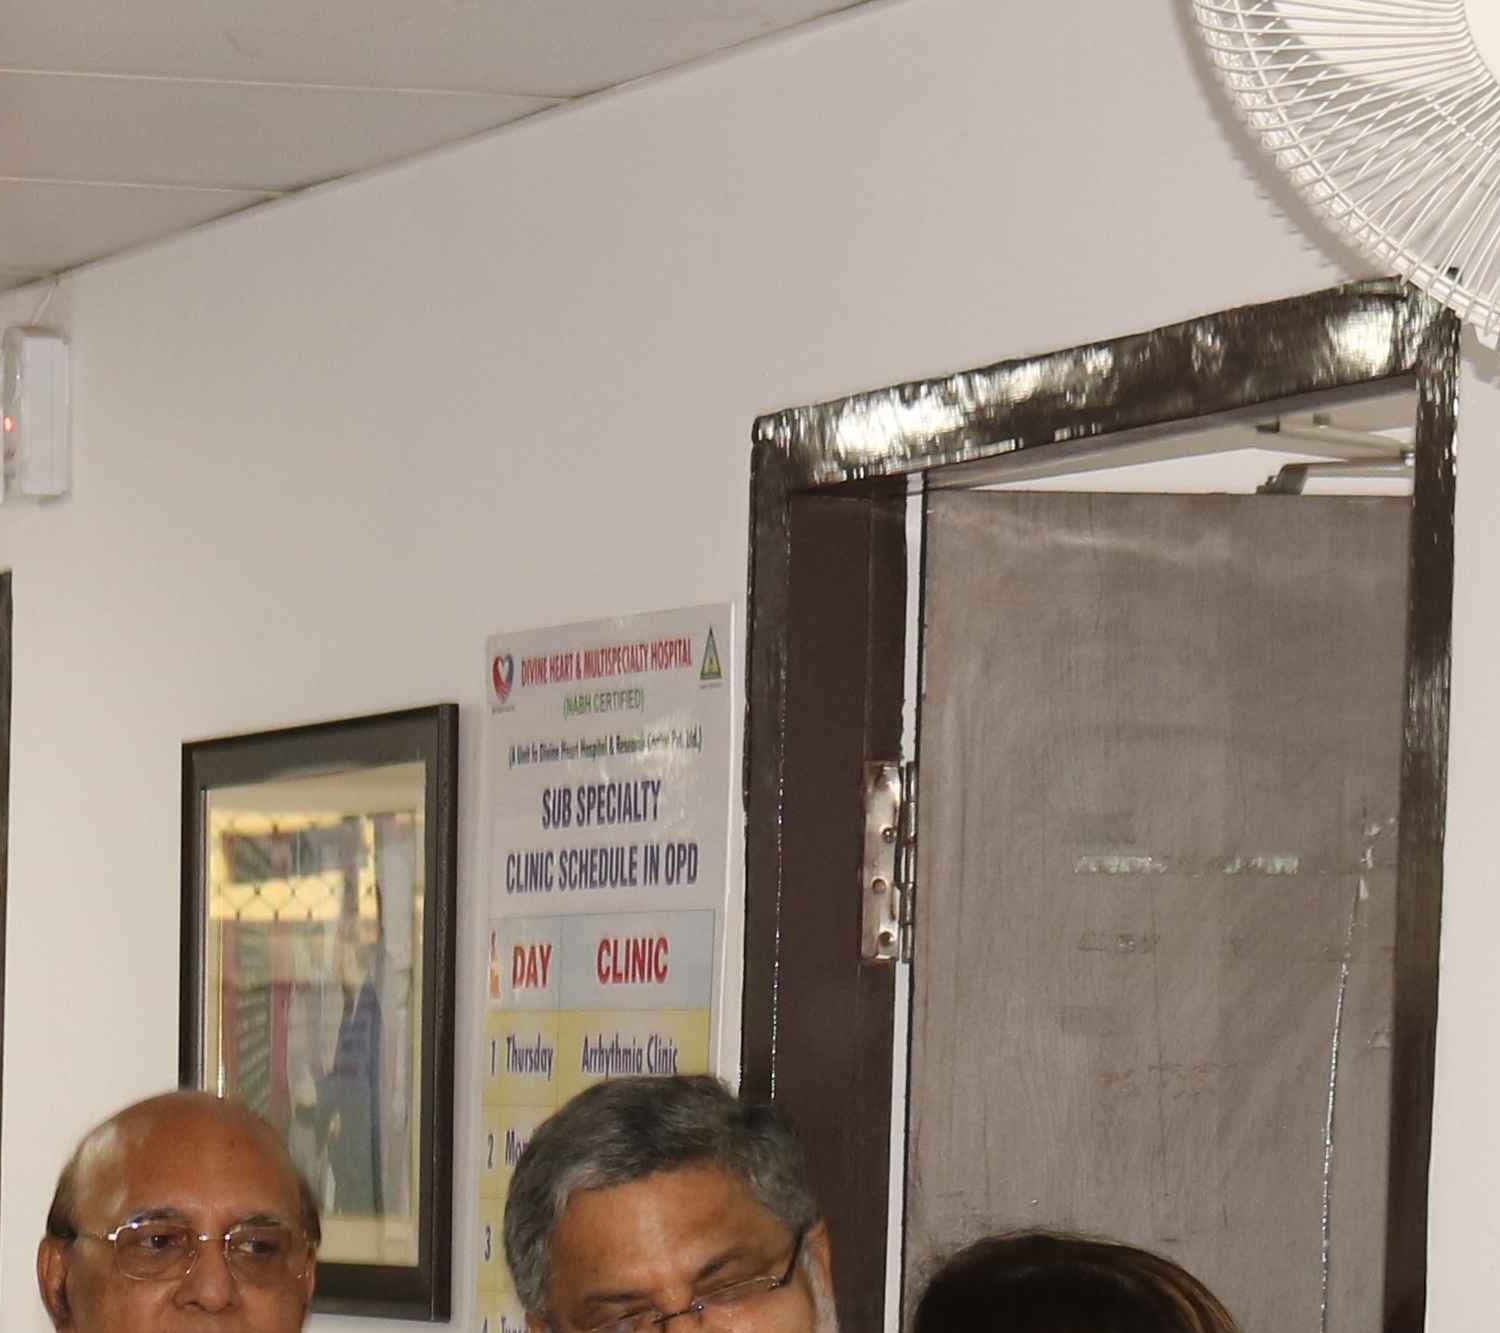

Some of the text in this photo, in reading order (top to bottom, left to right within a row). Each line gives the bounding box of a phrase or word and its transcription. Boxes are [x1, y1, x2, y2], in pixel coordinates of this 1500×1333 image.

[520, 655, 548, 688] DIVINE
[550, 648, 574, 684] HEART
[651, 636, 693, 672] HOSPITAL
[542, 779, 661, 830] SUB SPECIALTY
[506, 842, 699, 894] CLINIC SCHEDULE IN OPD
[512, 943, 552, 989] DAY
[597, 936, 670, 984] CLINIC
[506, 1032, 554, 1081] Thursday
[581, 1029, 643, 1080] Arrhythmia
[647, 1032, 679, 1074] Clinic
